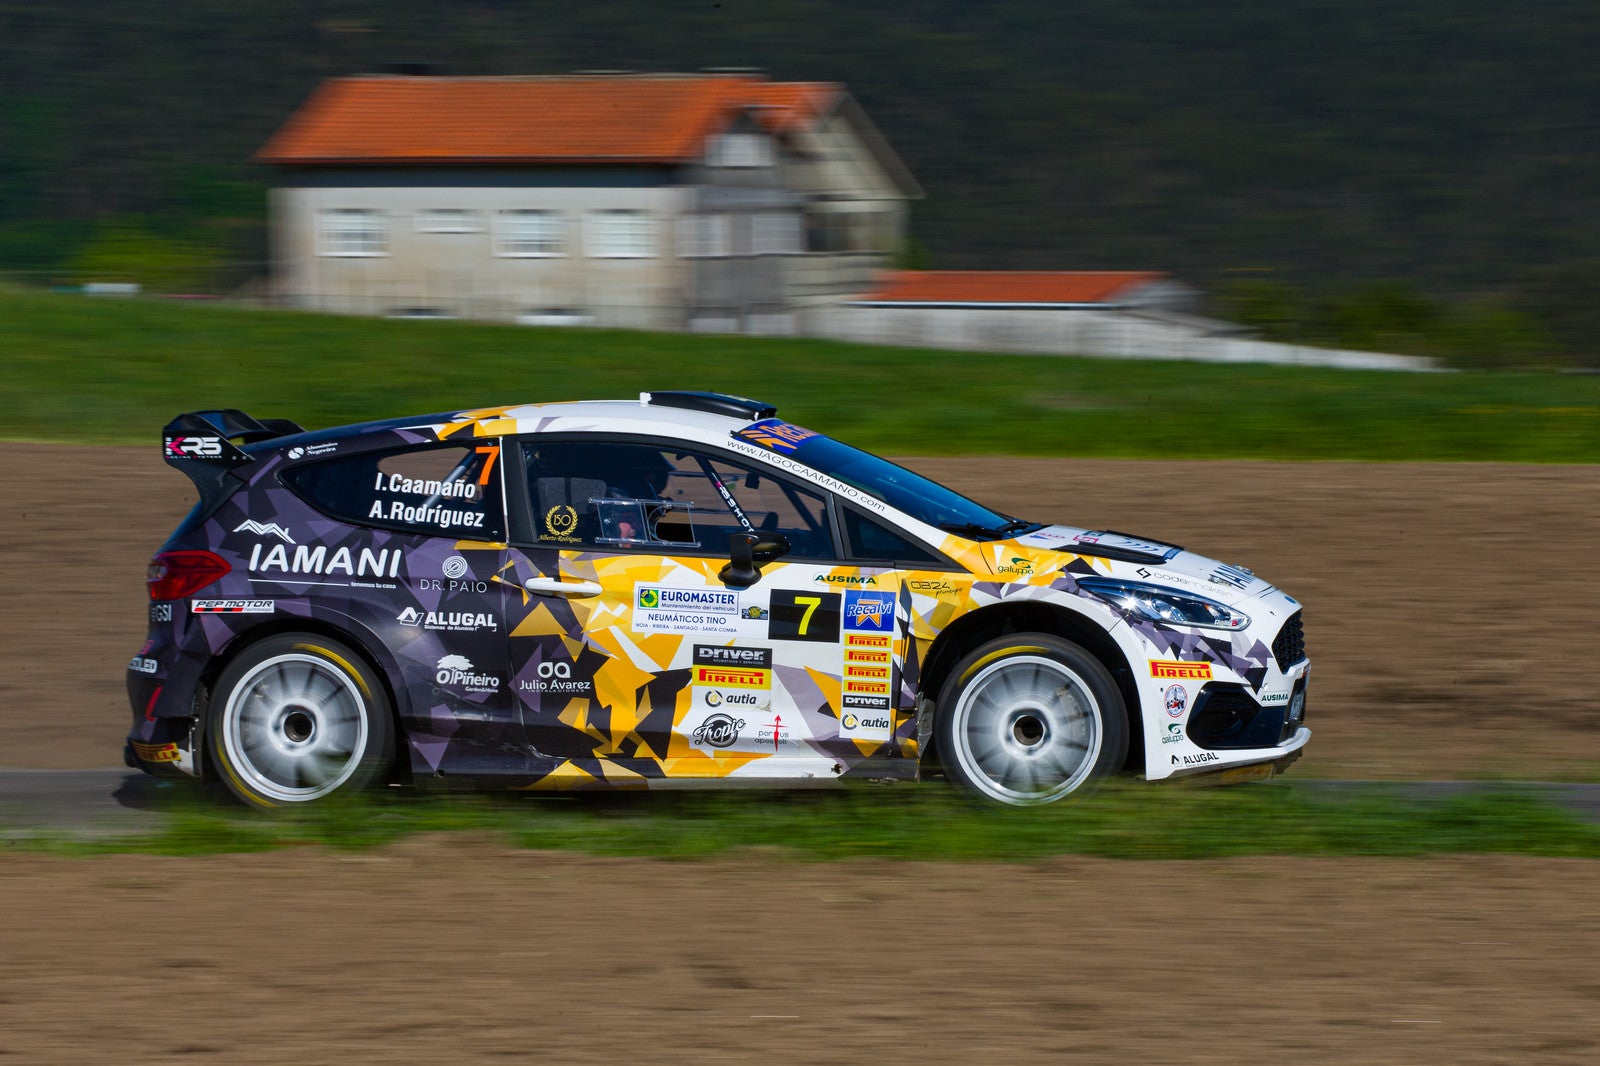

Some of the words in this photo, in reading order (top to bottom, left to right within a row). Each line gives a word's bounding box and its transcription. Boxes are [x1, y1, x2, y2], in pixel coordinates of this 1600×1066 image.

[475, 446, 500, 485] 7
[727, 440, 886, 512] www.IAGOCAAMANO.com
[375, 472, 476, 498] I.Caamaño
[368, 500, 485, 528] A.Rodríguez
[249, 543, 402, 578] IAMANI
[997, 565, 1034, 576] galuppo
[420, 579, 446, 591] DR.
[449, 580, 487, 593] PAIO
[815, 574, 877, 585] AUSIMA
[225, 600, 273, 608] MOTOR
[661, 591, 735, 605] EUROMASTER
[156, 604, 172, 622] GSI
[794, 596, 821, 635] 7
[847, 601, 893, 617] Recalvi
[424, 611, 497, 626] ALUGAL
[648, 612, 704, 624] NEUMÁTICOS
[706, 616, 727, 625] TINO
[848, 635, 889, 647] PIRELLI
[848, 651, 888, 662] PIRELLI
[698, 668, 765, 686] PIRELLI
[848, 666, 887, 678] PIRELLI
[1151, 661, 1212, 679] PIRELLI
[453, 671, 500, 687] Piñeiro
[519, 679, 548, 690] Julio
[847, 682, 886, 693] PIRELLI
[726, 693, 757, 705] autia
[1261, 693, 1289, 702] AUSIMA
[861, 717, 889, 729] autia
[693, 718, 747, 745] Tropic
[1161, 734, 1184, 745] galuppo
[1183, 752, 1219, 765] ALUGAL
